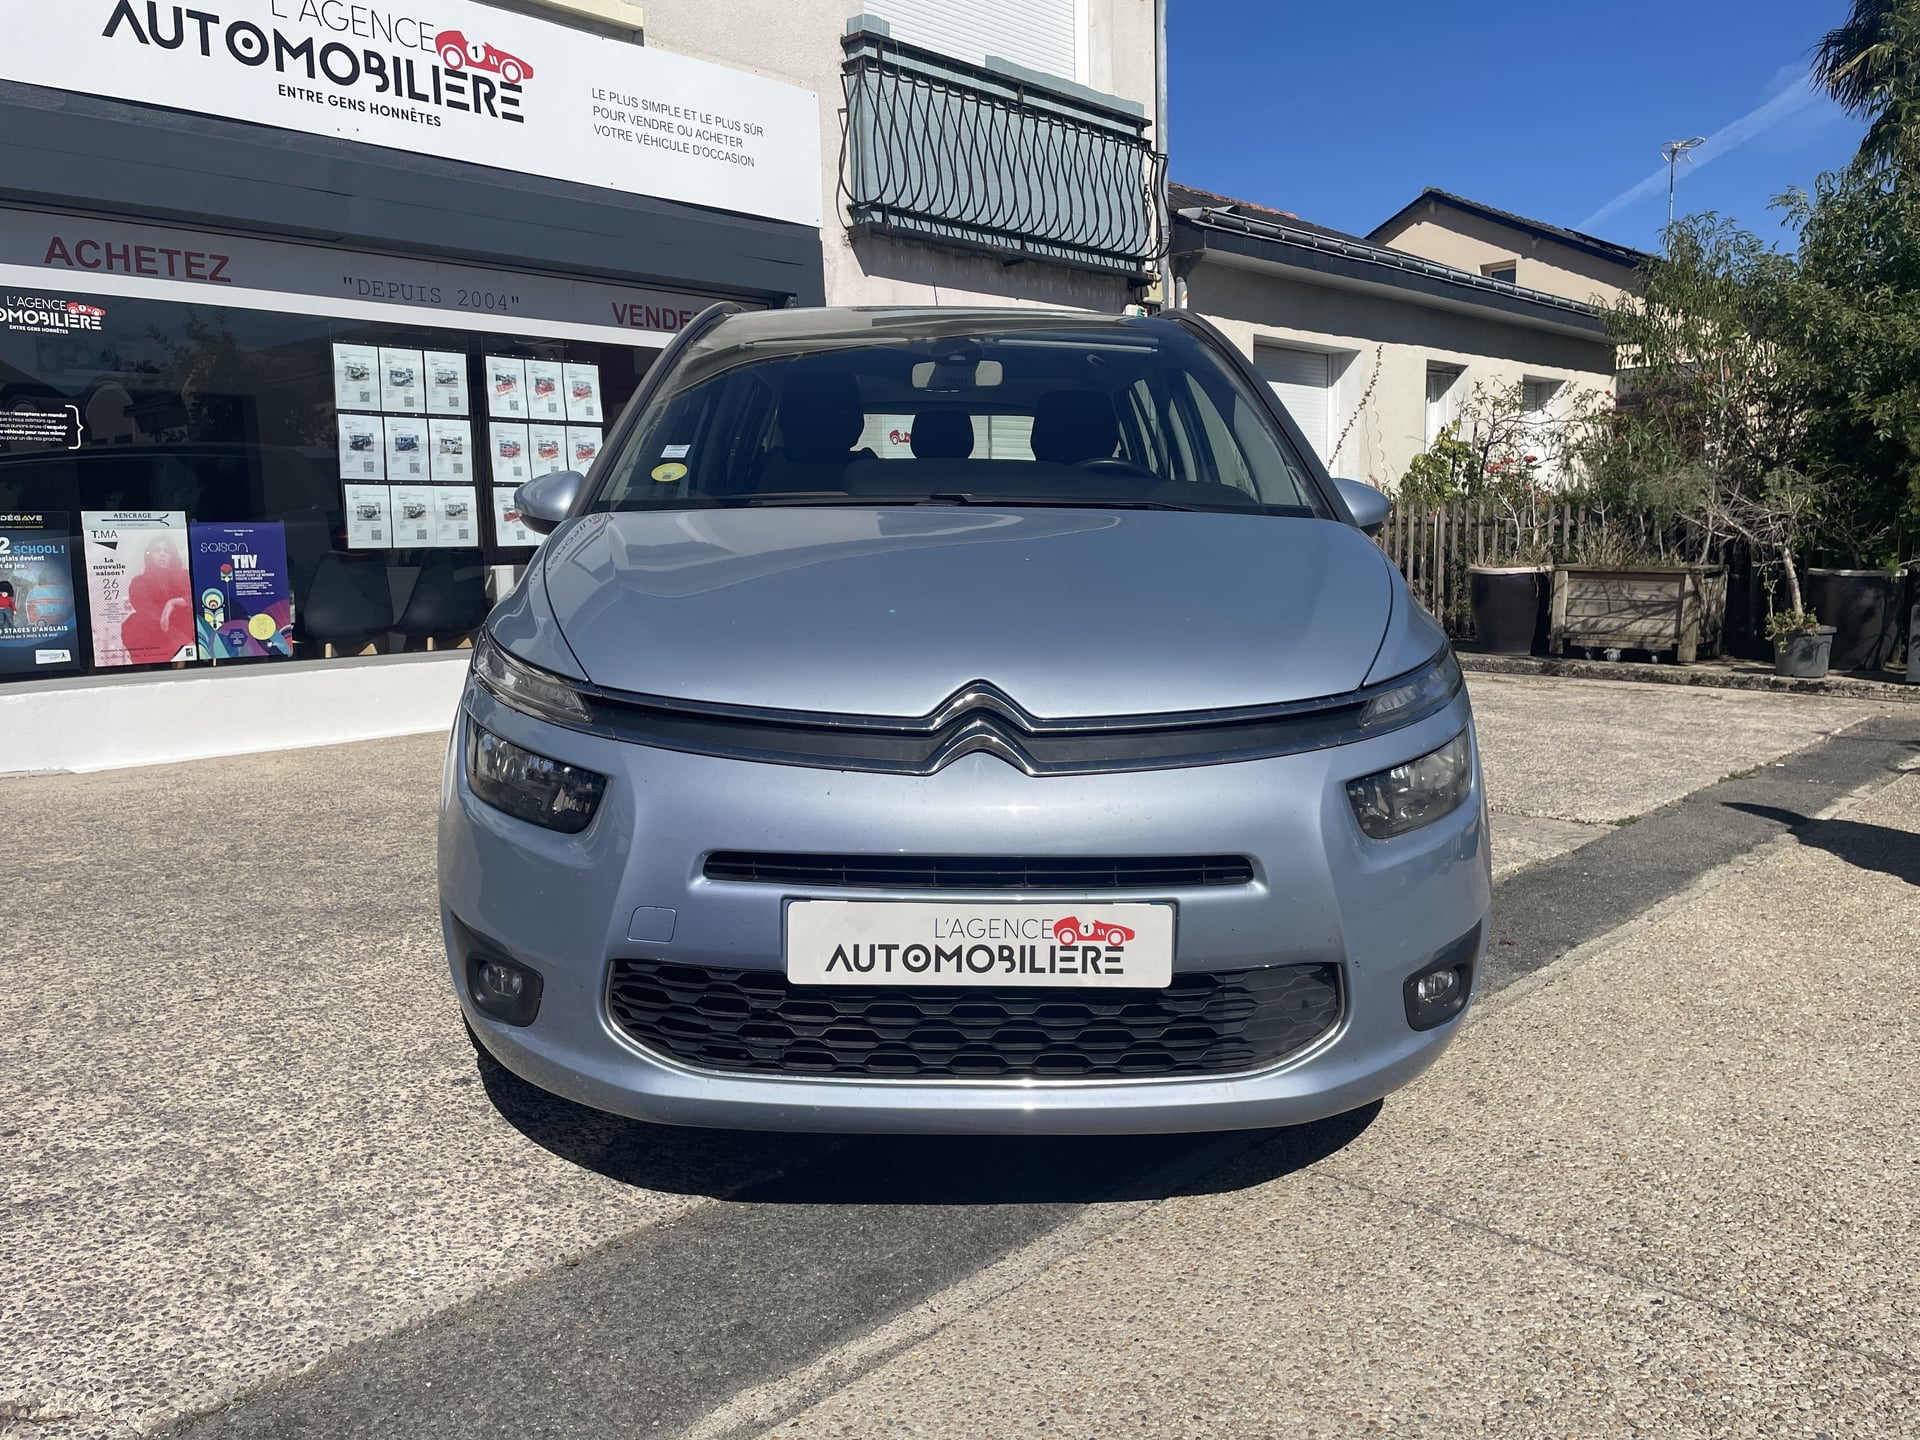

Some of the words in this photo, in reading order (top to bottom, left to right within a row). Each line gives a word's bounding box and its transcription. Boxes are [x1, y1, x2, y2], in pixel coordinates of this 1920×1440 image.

[278, 84, 324, 104] ENTRE
[328, 94, 365, 112] GENS
[370, 102, 441, 127] HONNÊTES
[592, 88, 606, 101] LE
[609, 91, 638, 109] PLUS
[641, 99, 681, 118] SIMPLE
[684, 109, 697, 121] ET
[700, 113, 712, 125] LE
[715, 116, 741, 132] PLUS
[743, 123, 764, 137] SÛR
[593, 105, 626, 123] POUR
[629, 113, 674, 134] VENDRE
[677, 124, 693, 138] OU
[695, 128, 743, 149] ACHETER
[594, 123, 633, 142] VOTRE
[635, 132, 690, 154] VÉHICULE
[692, 144, 755, 167] D'OCCASION
[44, 236, 231, 283] ACHETEZ
[342, 276, 441, 304] "DEPUIS
[457, 289, 520, 311] 2004"
[6, 295, 67, 311] L'AGENCE
[611, 302, 702, 330] VENDE
[91, 530, 118, 539] T.MA
[14, 545, 59, 554] SCHOOL
[200, 542, 249, 553] saison
[231, 554, 258, 569] THV
[102, 578, 119, 590] 26
[103, 589, 120, 601] 27
[32, 625, 69, 633] D'ANGLAIS
[934, 918, 1054, 939] L'AGENCE
